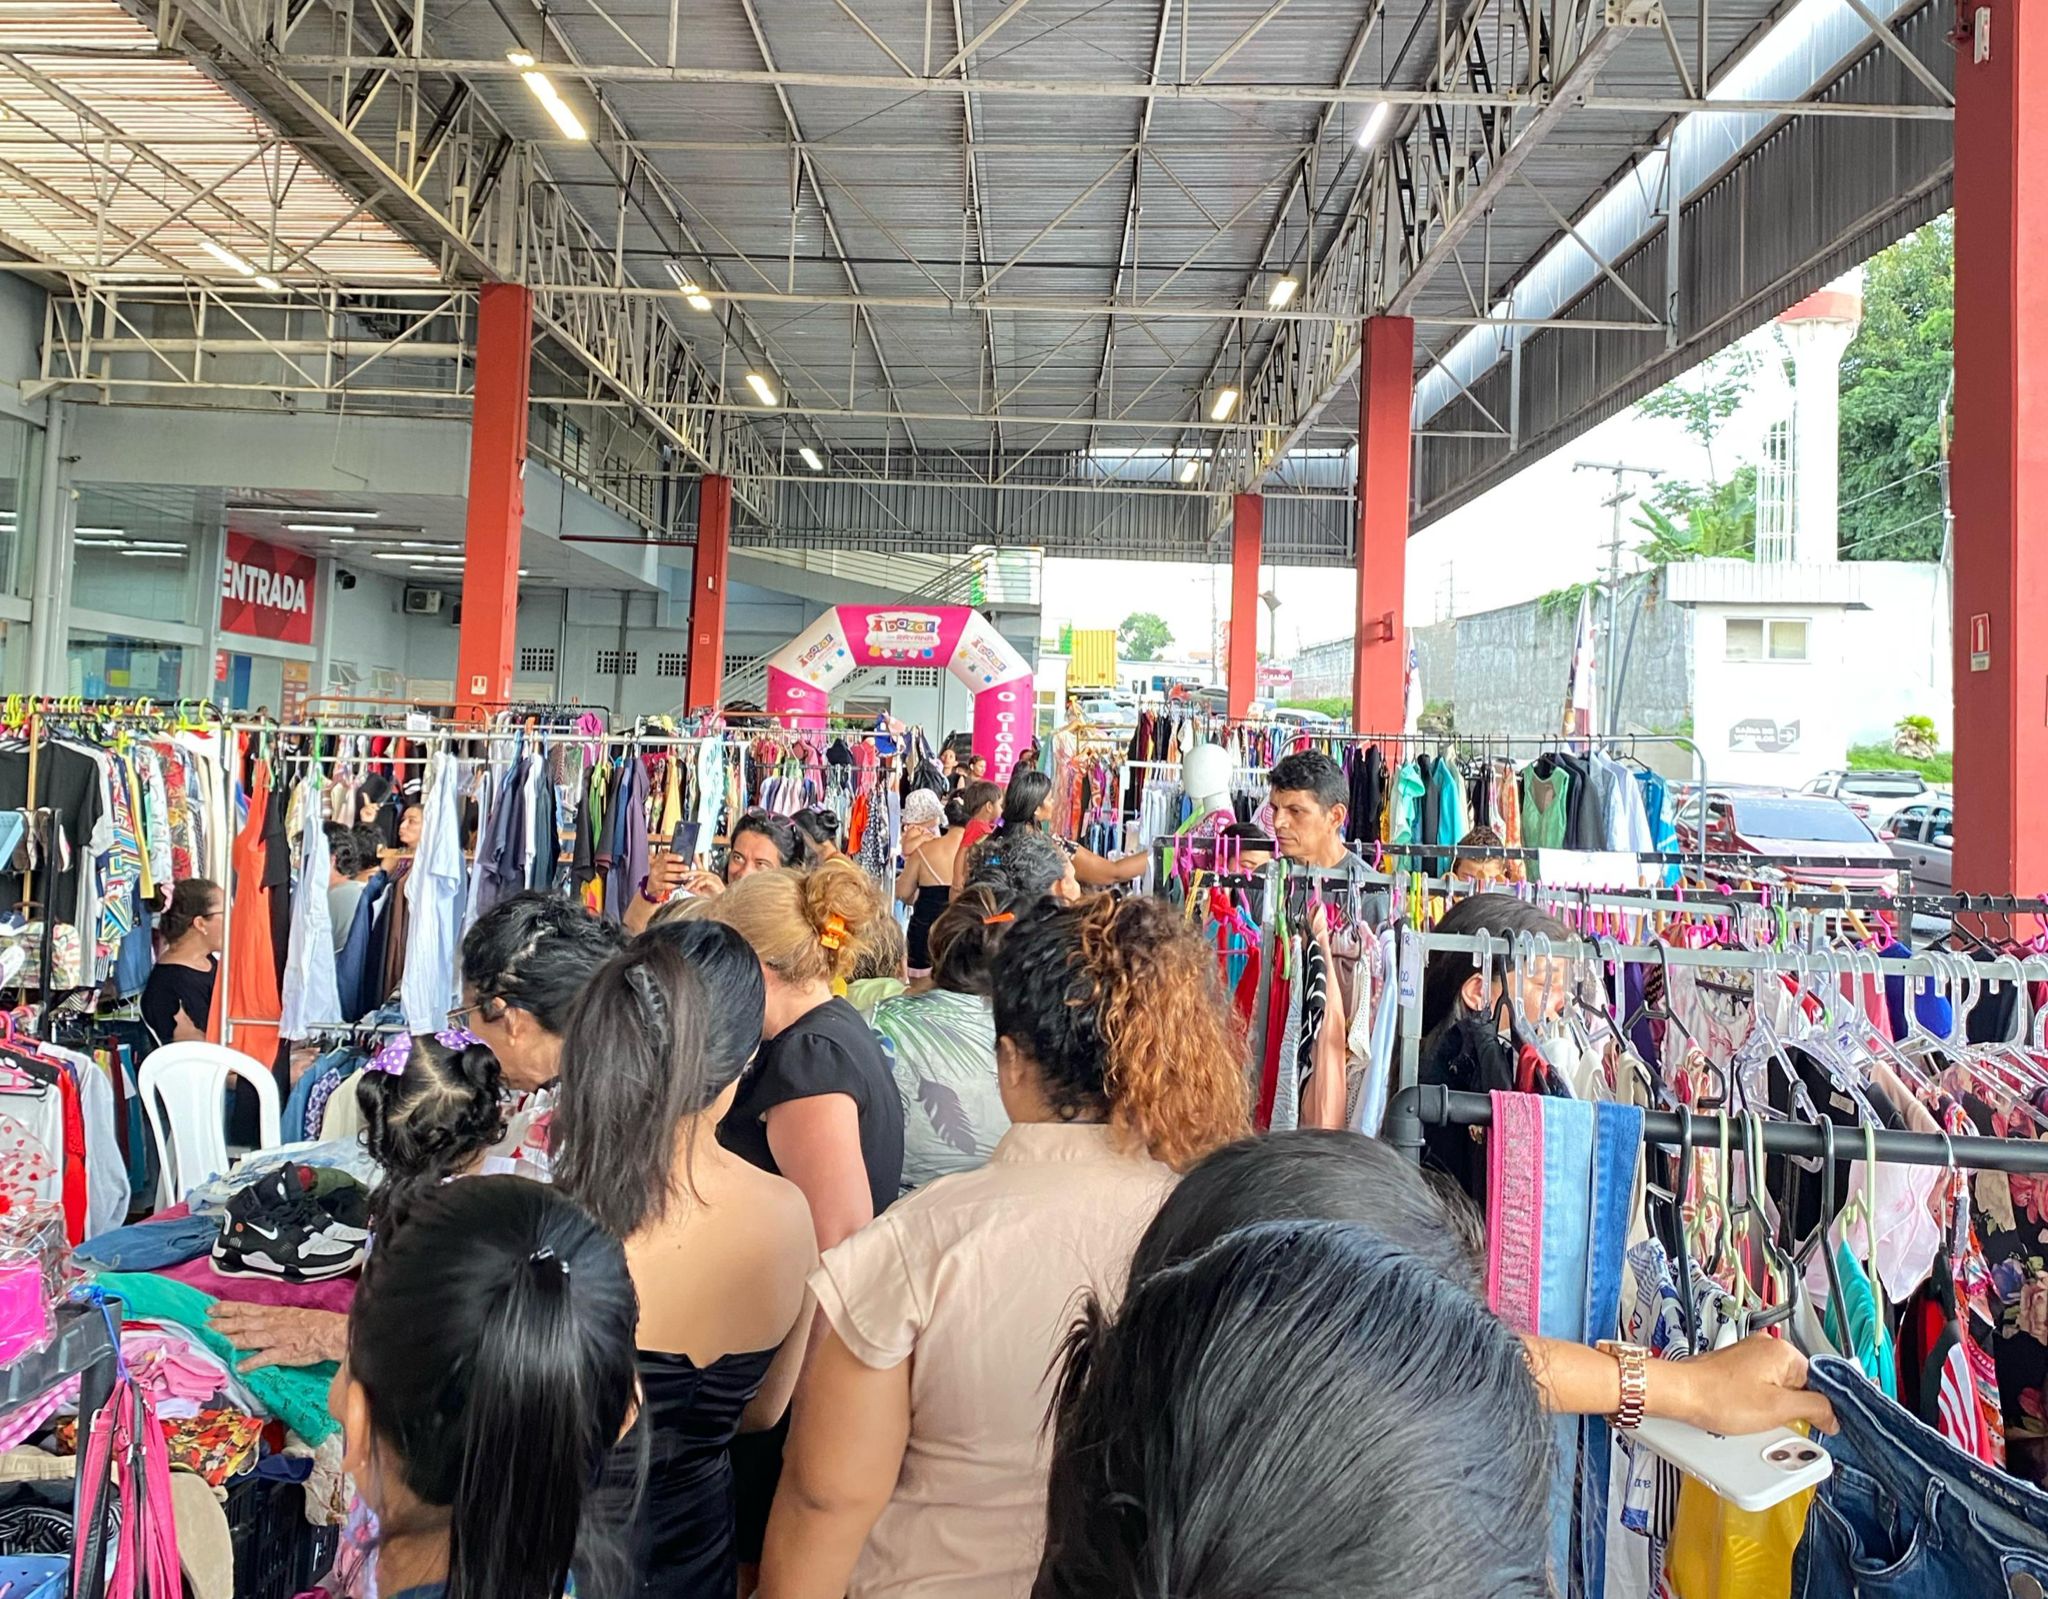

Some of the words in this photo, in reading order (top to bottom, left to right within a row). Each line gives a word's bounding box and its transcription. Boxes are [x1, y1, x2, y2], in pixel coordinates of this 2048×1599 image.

[222, 560, 306, 614] ENTRADA
[886, 618, 936, 632] bazar
[995, 712, 1015, 783] GIGANTE
